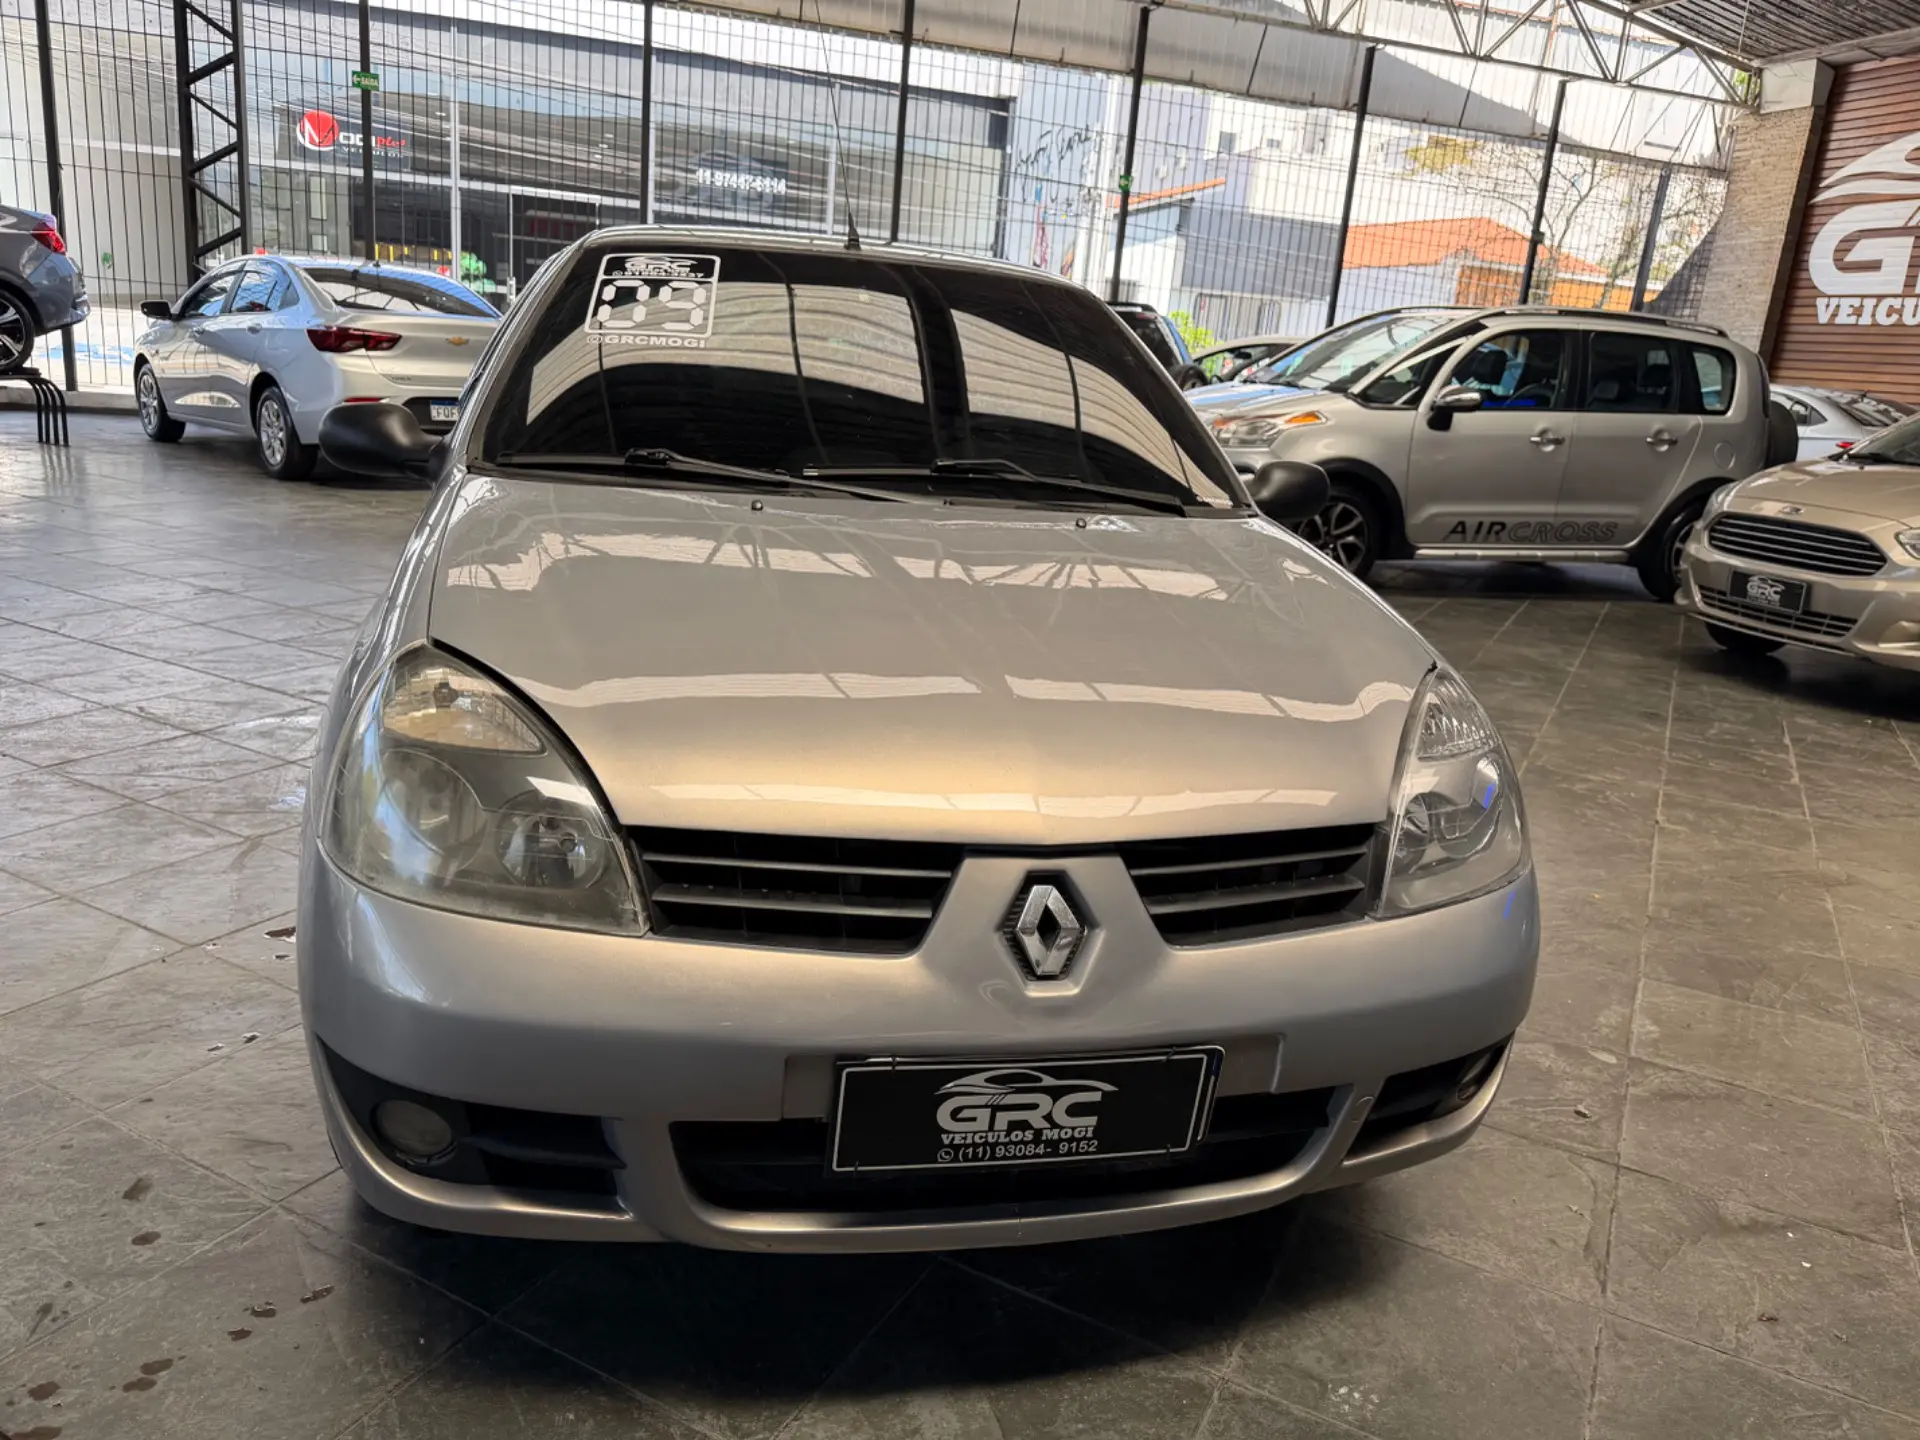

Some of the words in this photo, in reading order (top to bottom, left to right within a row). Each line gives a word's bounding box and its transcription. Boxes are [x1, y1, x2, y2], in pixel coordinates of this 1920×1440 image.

[587, 335, 706, 348] @GRCMOGI
[1442, 520, 1618, 543] AIRCROSS
[1747, 581, 1781, 598] GRC
[936, 1091, 1102, 1132] GRC
[941, 1130, 1034, 1145] VEICULOS
[1042, 1127, 1094, 1141] MOGI
[958, 1146, 990, 1161] (11)
[1058, 1140, 1098, 1154] 9152
